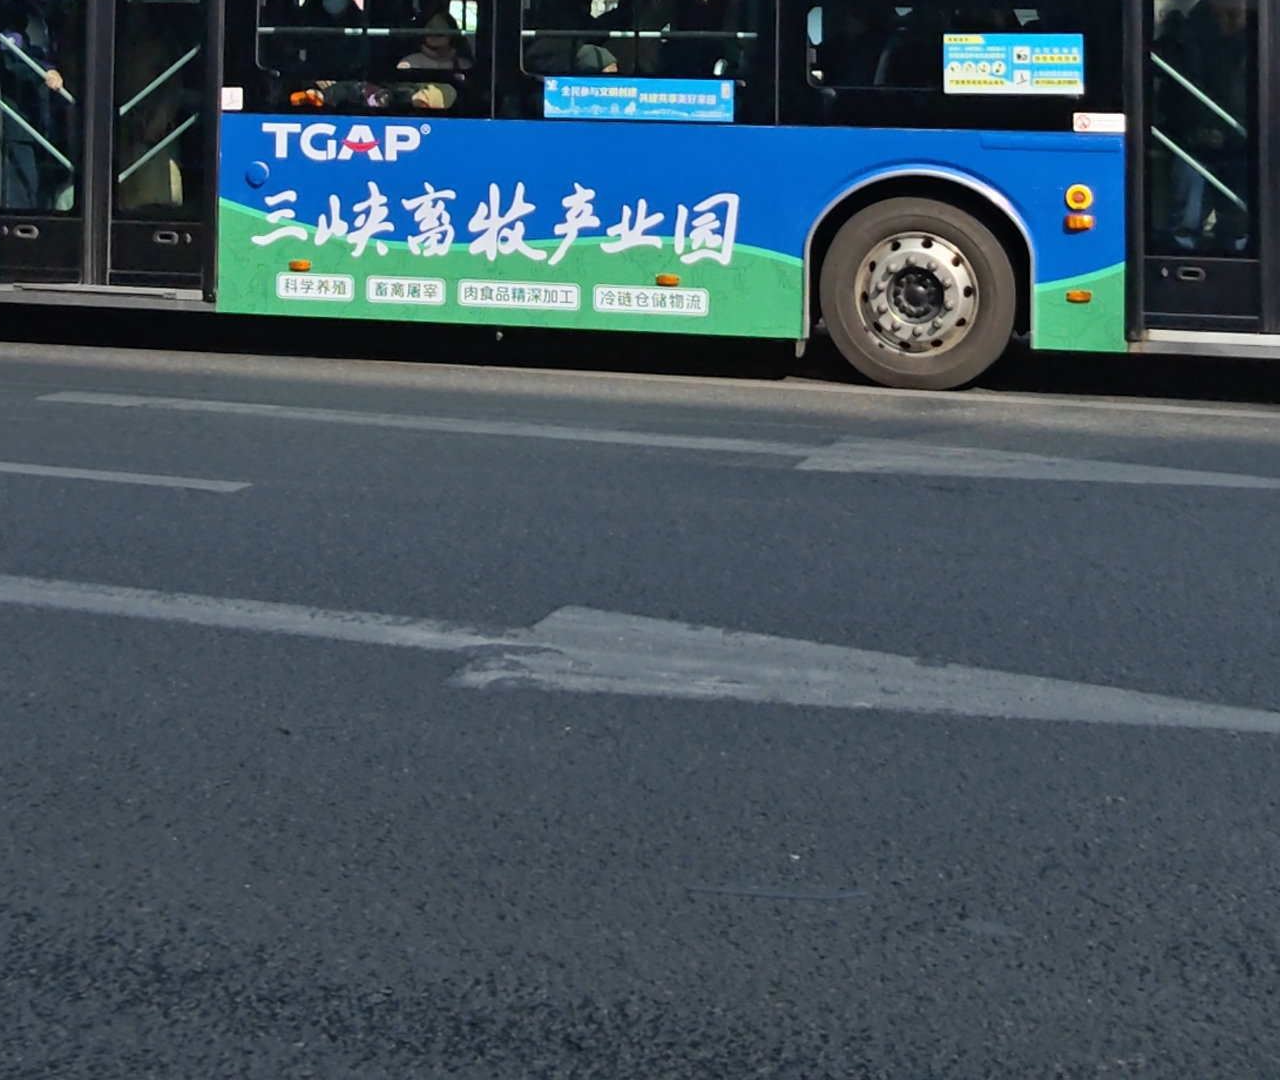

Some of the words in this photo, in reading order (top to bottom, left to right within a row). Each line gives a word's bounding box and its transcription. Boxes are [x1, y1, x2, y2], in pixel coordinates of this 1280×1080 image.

[251, 181, 740, 266] 三峡畜牧产业园
[284, 277, 347, 296] 科学养殖
[374, 281, 439, 300] 畜禽屠宰
[463, 284, 575, 305] 肉食品精深加工
[599, 290, 703, 311] 冷链仓储物流
